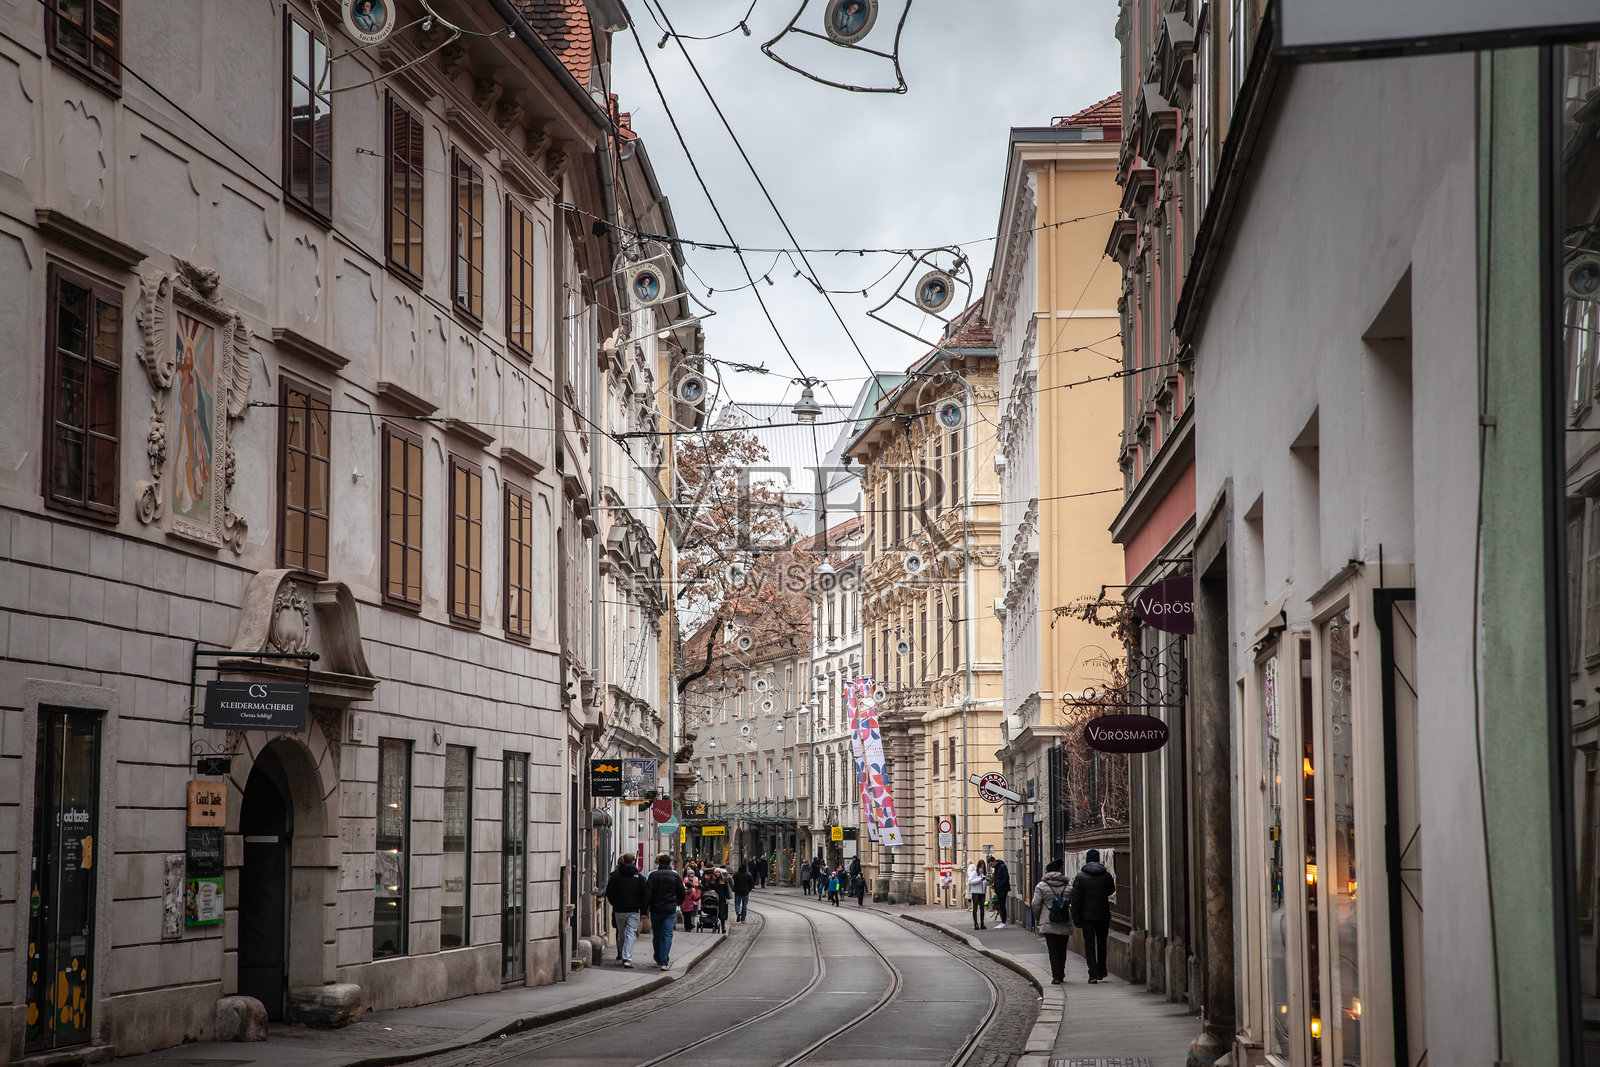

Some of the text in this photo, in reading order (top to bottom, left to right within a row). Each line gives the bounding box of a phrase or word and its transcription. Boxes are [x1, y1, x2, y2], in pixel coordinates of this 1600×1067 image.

[357, 22, 393, 42] Sackstrasse
[248, 683, 268, 698] CS
[220, 701, 294, 711] KLEIDERMACHEREI
[1088, 726, 1166, 741] VÖRÖSMARTY
[984, 775, 1006, 787] TABAK
[196, 791, 222, 806] Good Taste
[74, 809, 89, 823] taste
